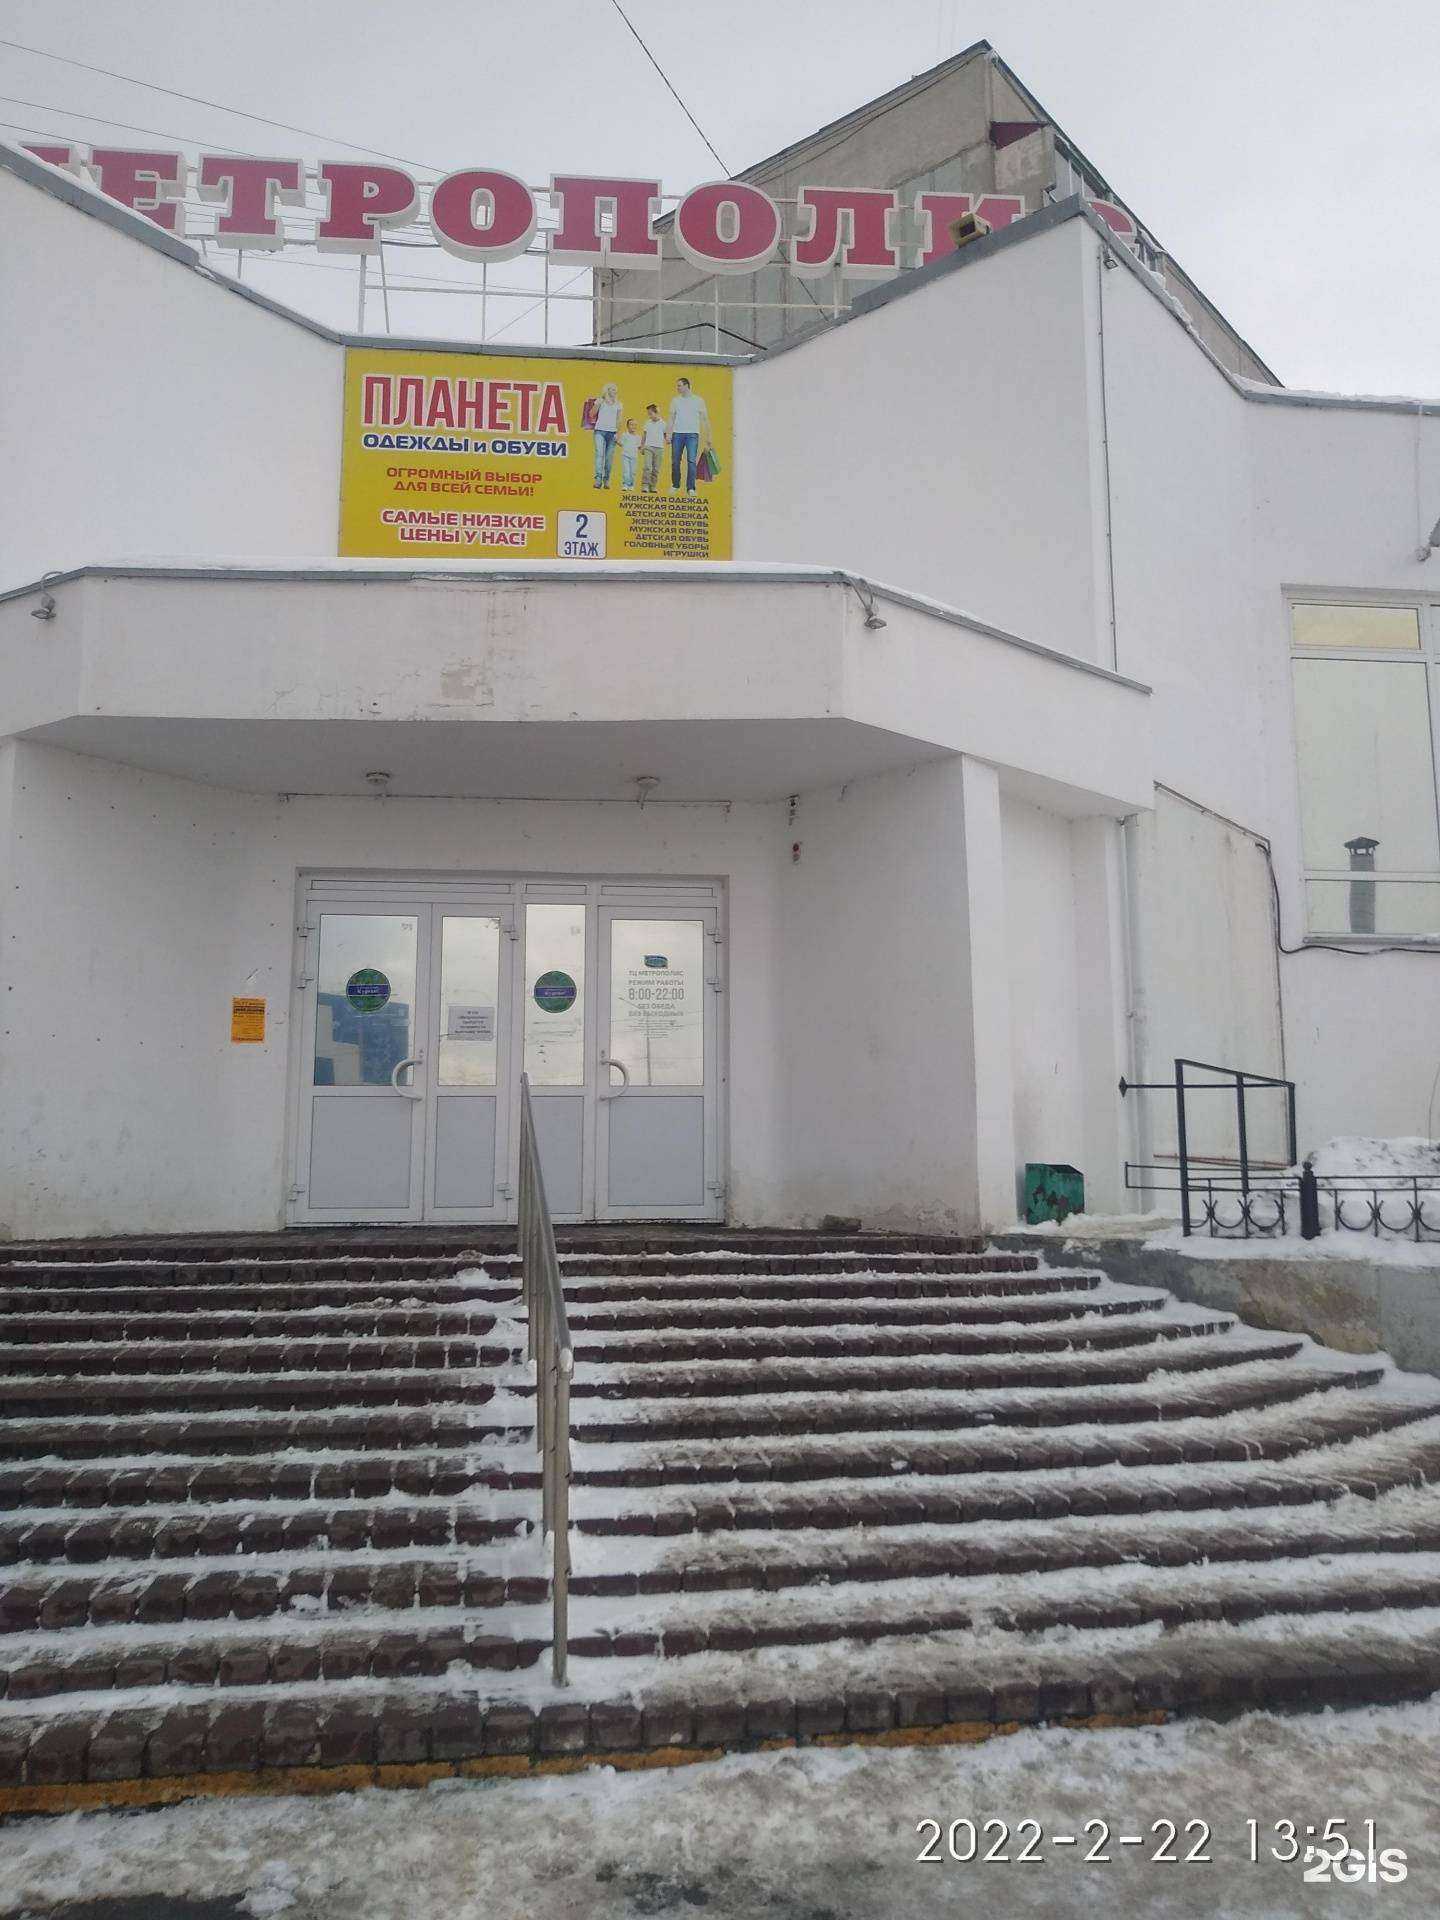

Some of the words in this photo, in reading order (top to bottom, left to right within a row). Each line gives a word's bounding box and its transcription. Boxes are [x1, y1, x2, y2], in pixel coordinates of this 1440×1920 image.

[18, 142, 1138, 278] ЕТРОПОЛИ
[363, 375, 567, 434] ПЛАНЕТА
[363, 434, 469, 452] ОДЕЖДЫ
[474, 442, 487, 453] и
[491, 440, 567, 457] ОБУВИ
[386, 466, 481, 482] ОГРОМНЫЙ
[484, 471, 543, 484] ВЫБОР
[393, 481, 428, 492] ДЛЯ
[430, 481, 472, 495] ВСЕЙ
[474, 485, 534, 497] СЕМЬИ!
[619, 502, 667, 511] МУЖСКАЯ
[668, 504, 709, 512] ОДЕЖДА
[622, 495, 667, 503] ЖЕНСКАЯ
[381, 510, 459, 527] САМЫЕ
[461, 513, 545, 530] НИЗКИЕ
[625, 510, 667, 518] ДЕТСКАЯ
[668, 512, 709, 520] ОДЕЖДА
[632, 518, 677, 527] ЖЕНСКАЯ
[575, 513, 589, 539] 2
[629, 526, 677, 534] МУЖСКАЯ
[399, 528, 461, 544] ЦЕНЫ
[463, 530, 478, 544] У
[481, 531, 527, 546] НАС!
[635, 533, 677, 541] ДЕТСКАЯ
[564, 541, 600, 557] ЭТАЖ
[624, 540, 674, 549] ГОЛОВНЫЕ
[676, 543, 709, 551] УБОРЫ
[663, 550, 709, 558] ИГРУШКИ
